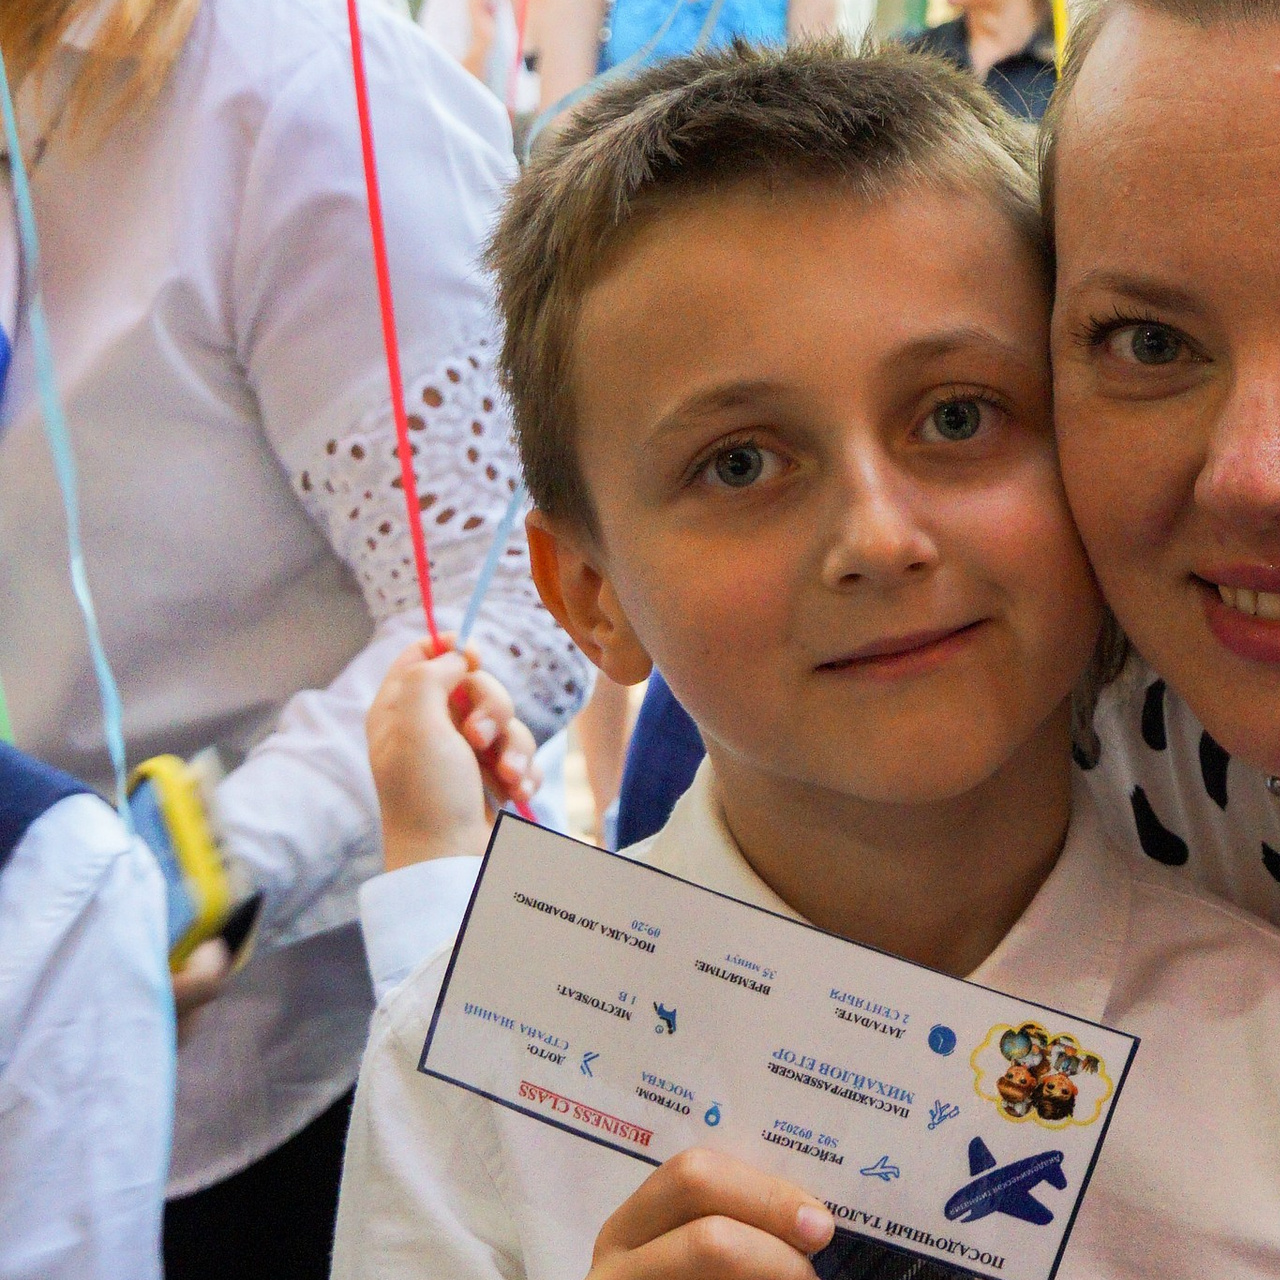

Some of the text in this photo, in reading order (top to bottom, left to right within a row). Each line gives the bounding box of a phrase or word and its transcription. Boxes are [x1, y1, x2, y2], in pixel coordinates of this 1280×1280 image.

[513, 892, 656, 954] ПОСАДКА ДО/ BOARDING:
[631, 919, 661, 938] 09:20
[694, 959, 771, 996] ВРЕМЯ/TIME:
[725, 954, 778, 980] 35 минут
[556, 984, 631, 1021] МЕСТО/SEAT:
[829, 988, 910, 1025] 2 СЕНТЯБРЯ
[464, 1002, 570, 1051] СТРАНА ЗНАНИЙ
[834, 1007, 906, 1039] ДАТА/DATE:
[642, 1071, 694, 1101] МОСКВА
[767, 1062, 910, 1119] ПАССАЖИР/PASSENGER:
[772, 1048, 915, 1105] МИХАЙЛОВ ЕГОР
[518, 1082, 654, 1147] BUSINESS CLASS
[635, 1086, 691, 1116] ОТ/FROM:
[761, 1129, 844, 1166] РЕЙС/FLIGHT:
[773, 1119, 839, 1148] S02 092024
[884, 1220, 1005, 1270] ПОСАДОЧНЫЙ
